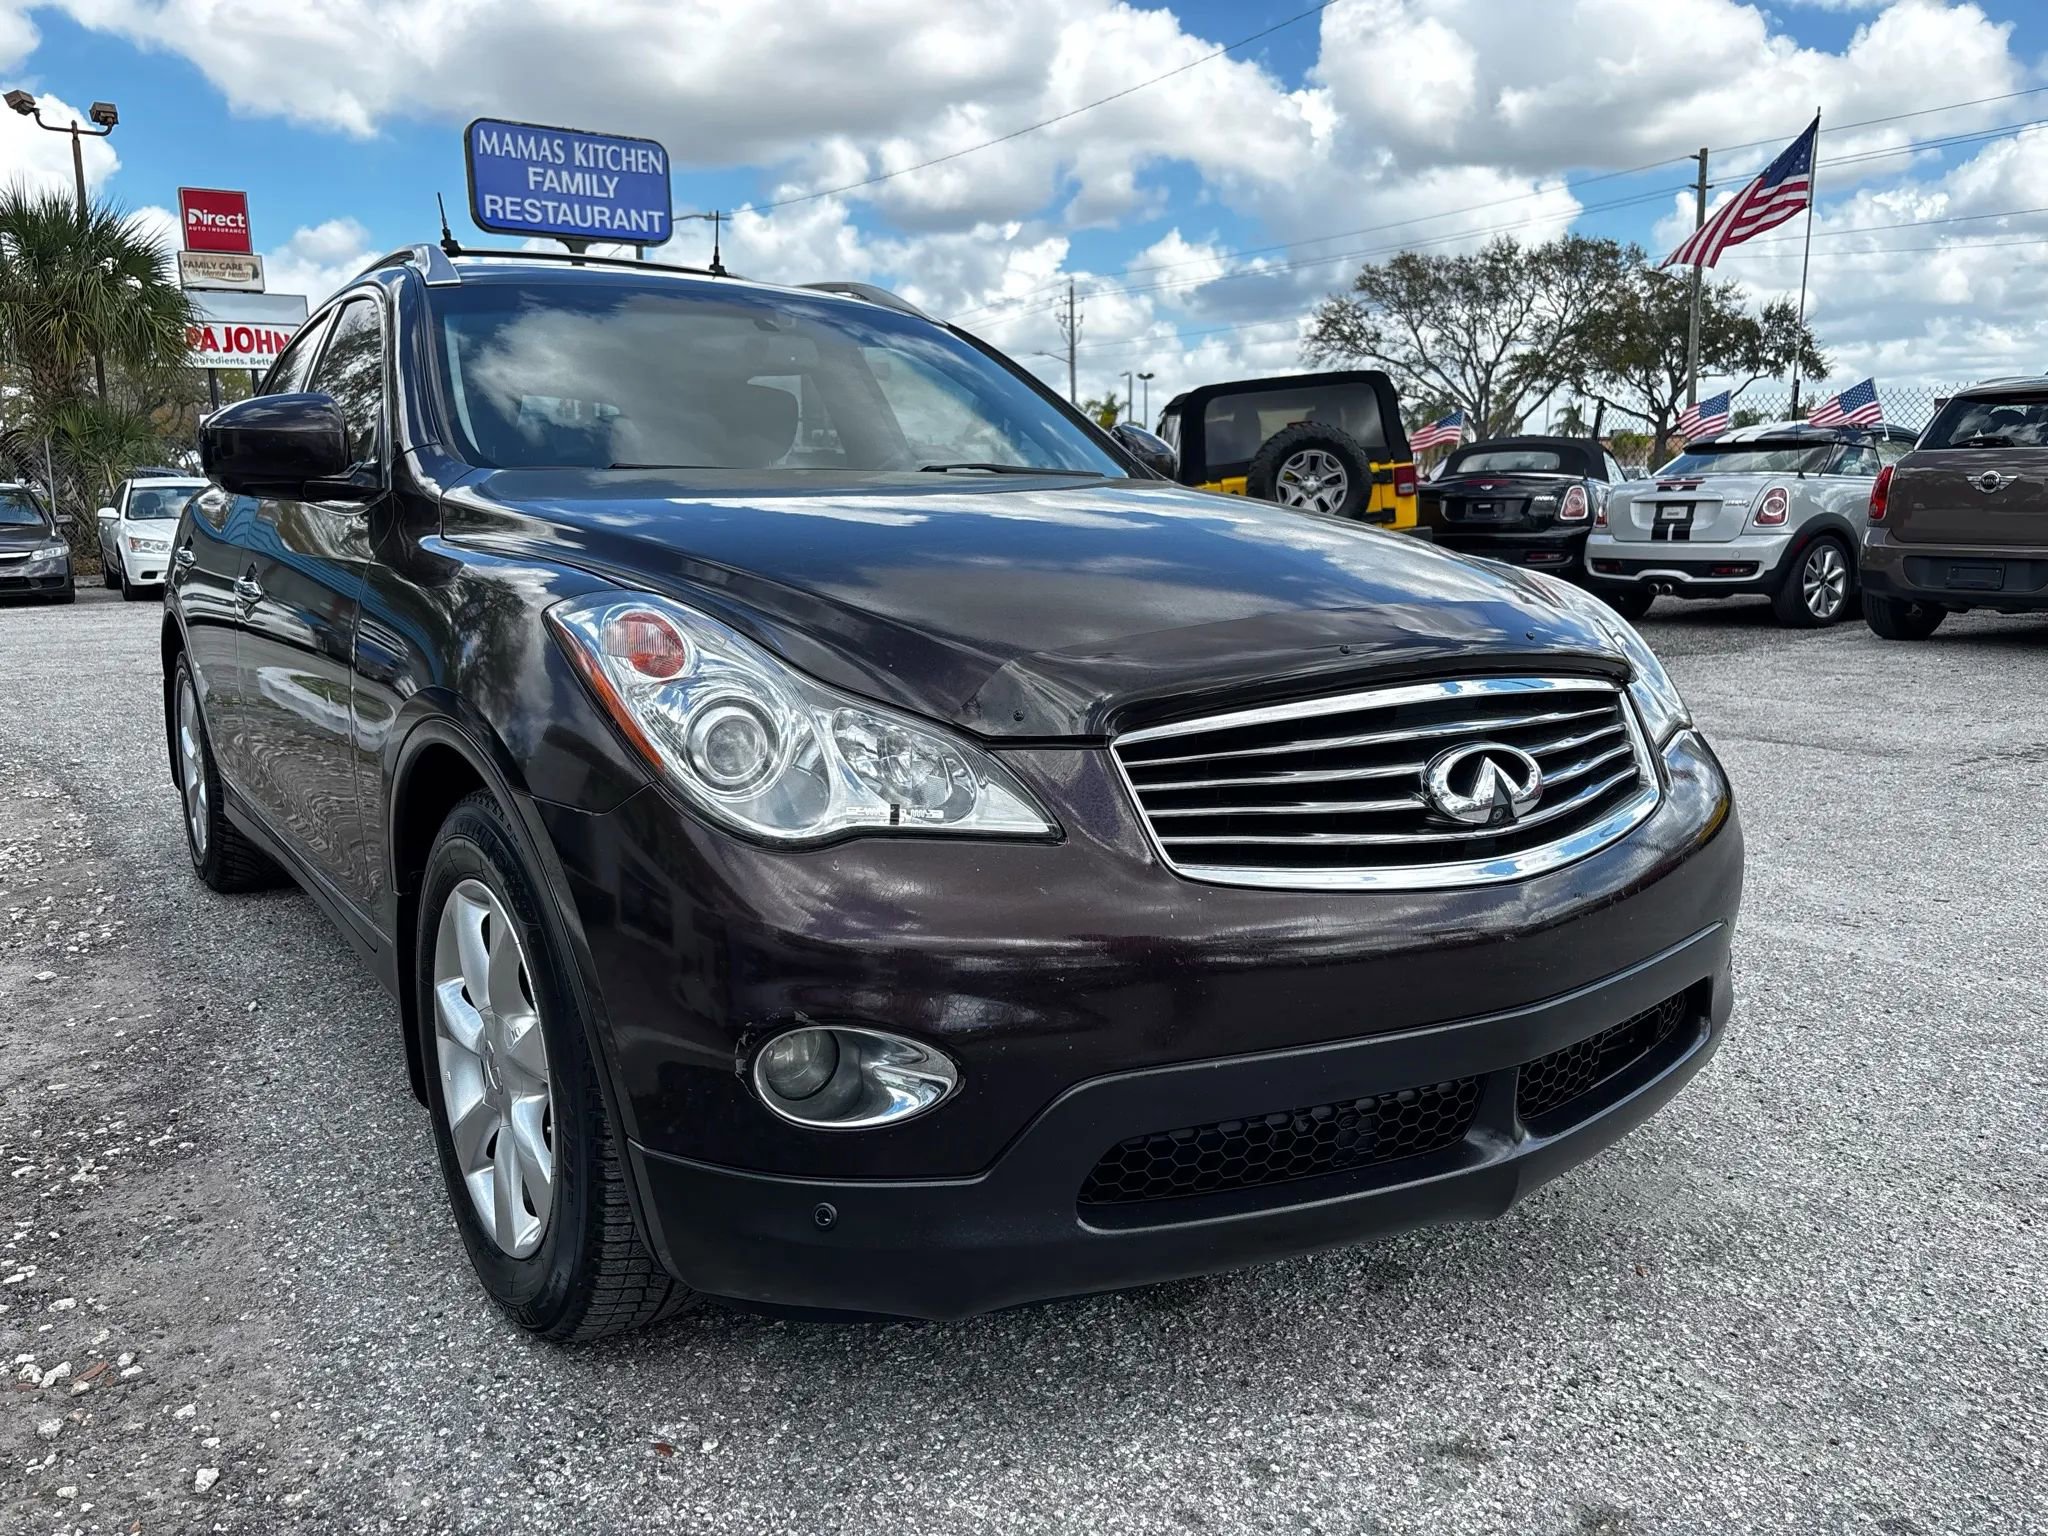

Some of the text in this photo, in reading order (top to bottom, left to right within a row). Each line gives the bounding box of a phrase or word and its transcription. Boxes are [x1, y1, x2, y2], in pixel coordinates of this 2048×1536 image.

[479, 130, 664, 175] MAMAS KITCHEN
[528, 167, 619, 198] FAMILY
[188, 208, 246, 227] Direct
[484, 195, 664, 233] RESTAURANT
[183, 261, 243, 270] FAMILY CARE
[190, 356, 247, 365] ngredients.
